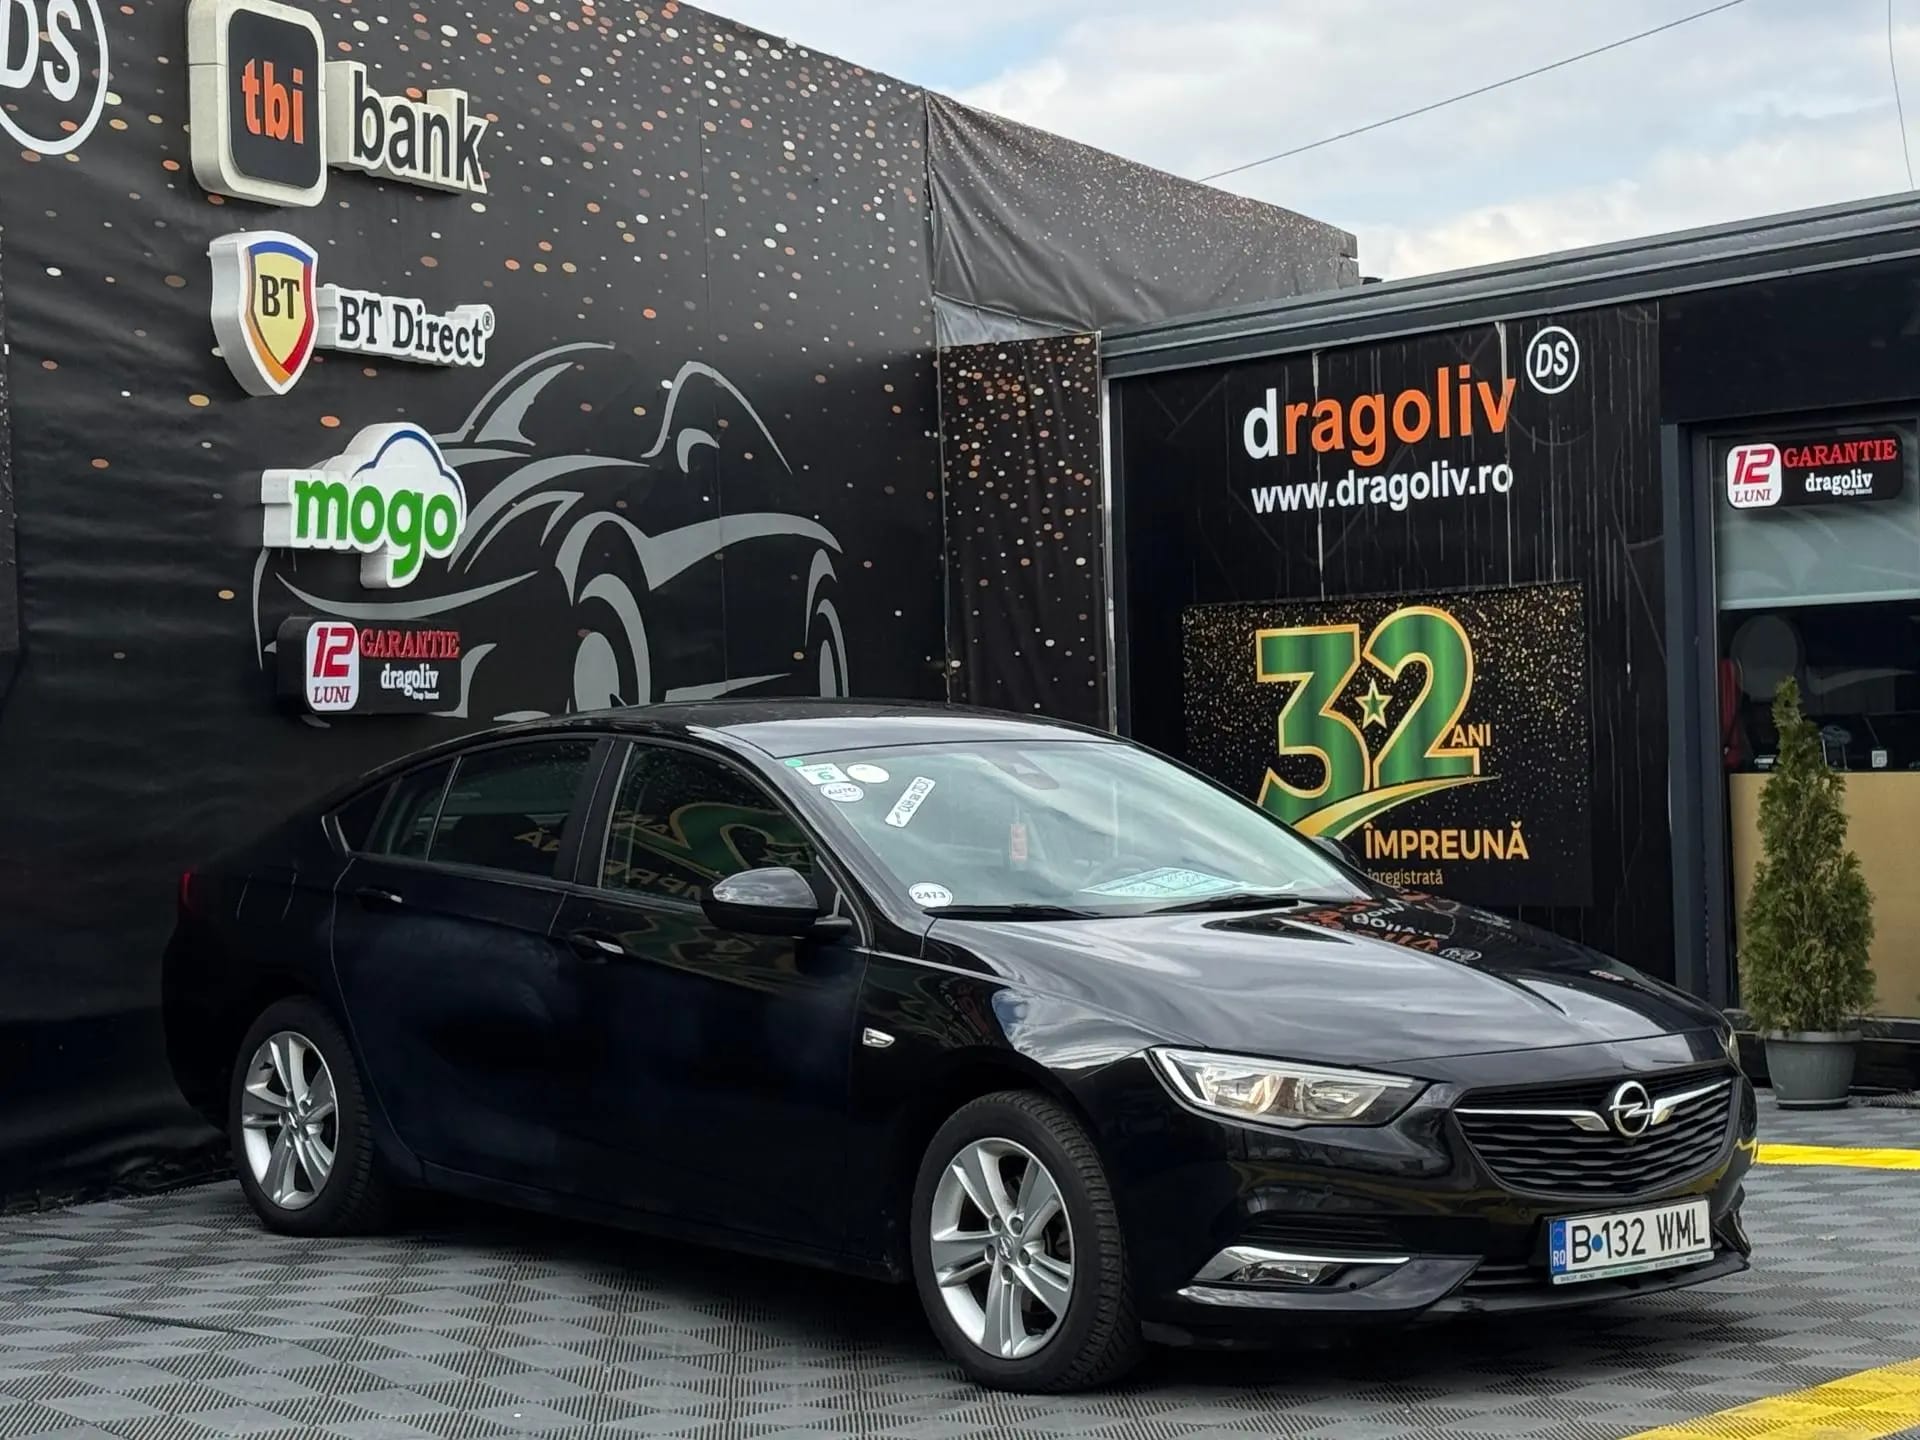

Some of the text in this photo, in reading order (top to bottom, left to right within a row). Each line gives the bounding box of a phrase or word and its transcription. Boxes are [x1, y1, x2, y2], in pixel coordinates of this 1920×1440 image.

[0, 0, 81, 101] DS
[242, 58, 304, 144] tbi
[354, 71, 487, 187] bank
[260, 274, 299, 320] BT
[339, 295, 382, 344] BT
[1535, 341, 1569, 379] DS
[1243, 363, 1516, 466] dragoliv
[1733, 449, 1775, 486] 12
[1783, 439, 1898, 468] GARANTIE
[1251, 460, 1513, 514] www.dragoliv.ro
[1734, 488, 1773, 503] LUNI
[1805, 468, 1873, 496] dragoliv
[295, 480, 457, 579] mogo
[312, 627, 355, 678] 12
[359, 628, 460, 660] GARANTIE
[313, 686, 350, 704] LUNI
[381, 662, 439, 697] dragoliv
[1256, 605, 1479, 826] 32
[1450, 723, 1492, 748] ANI
[1363, 820, 1530, 861] ÎMPREUNĂ
[1571, 1208, 1705, 1264] B 132 WML
[1552, 1250, 1566, 1267] RO
